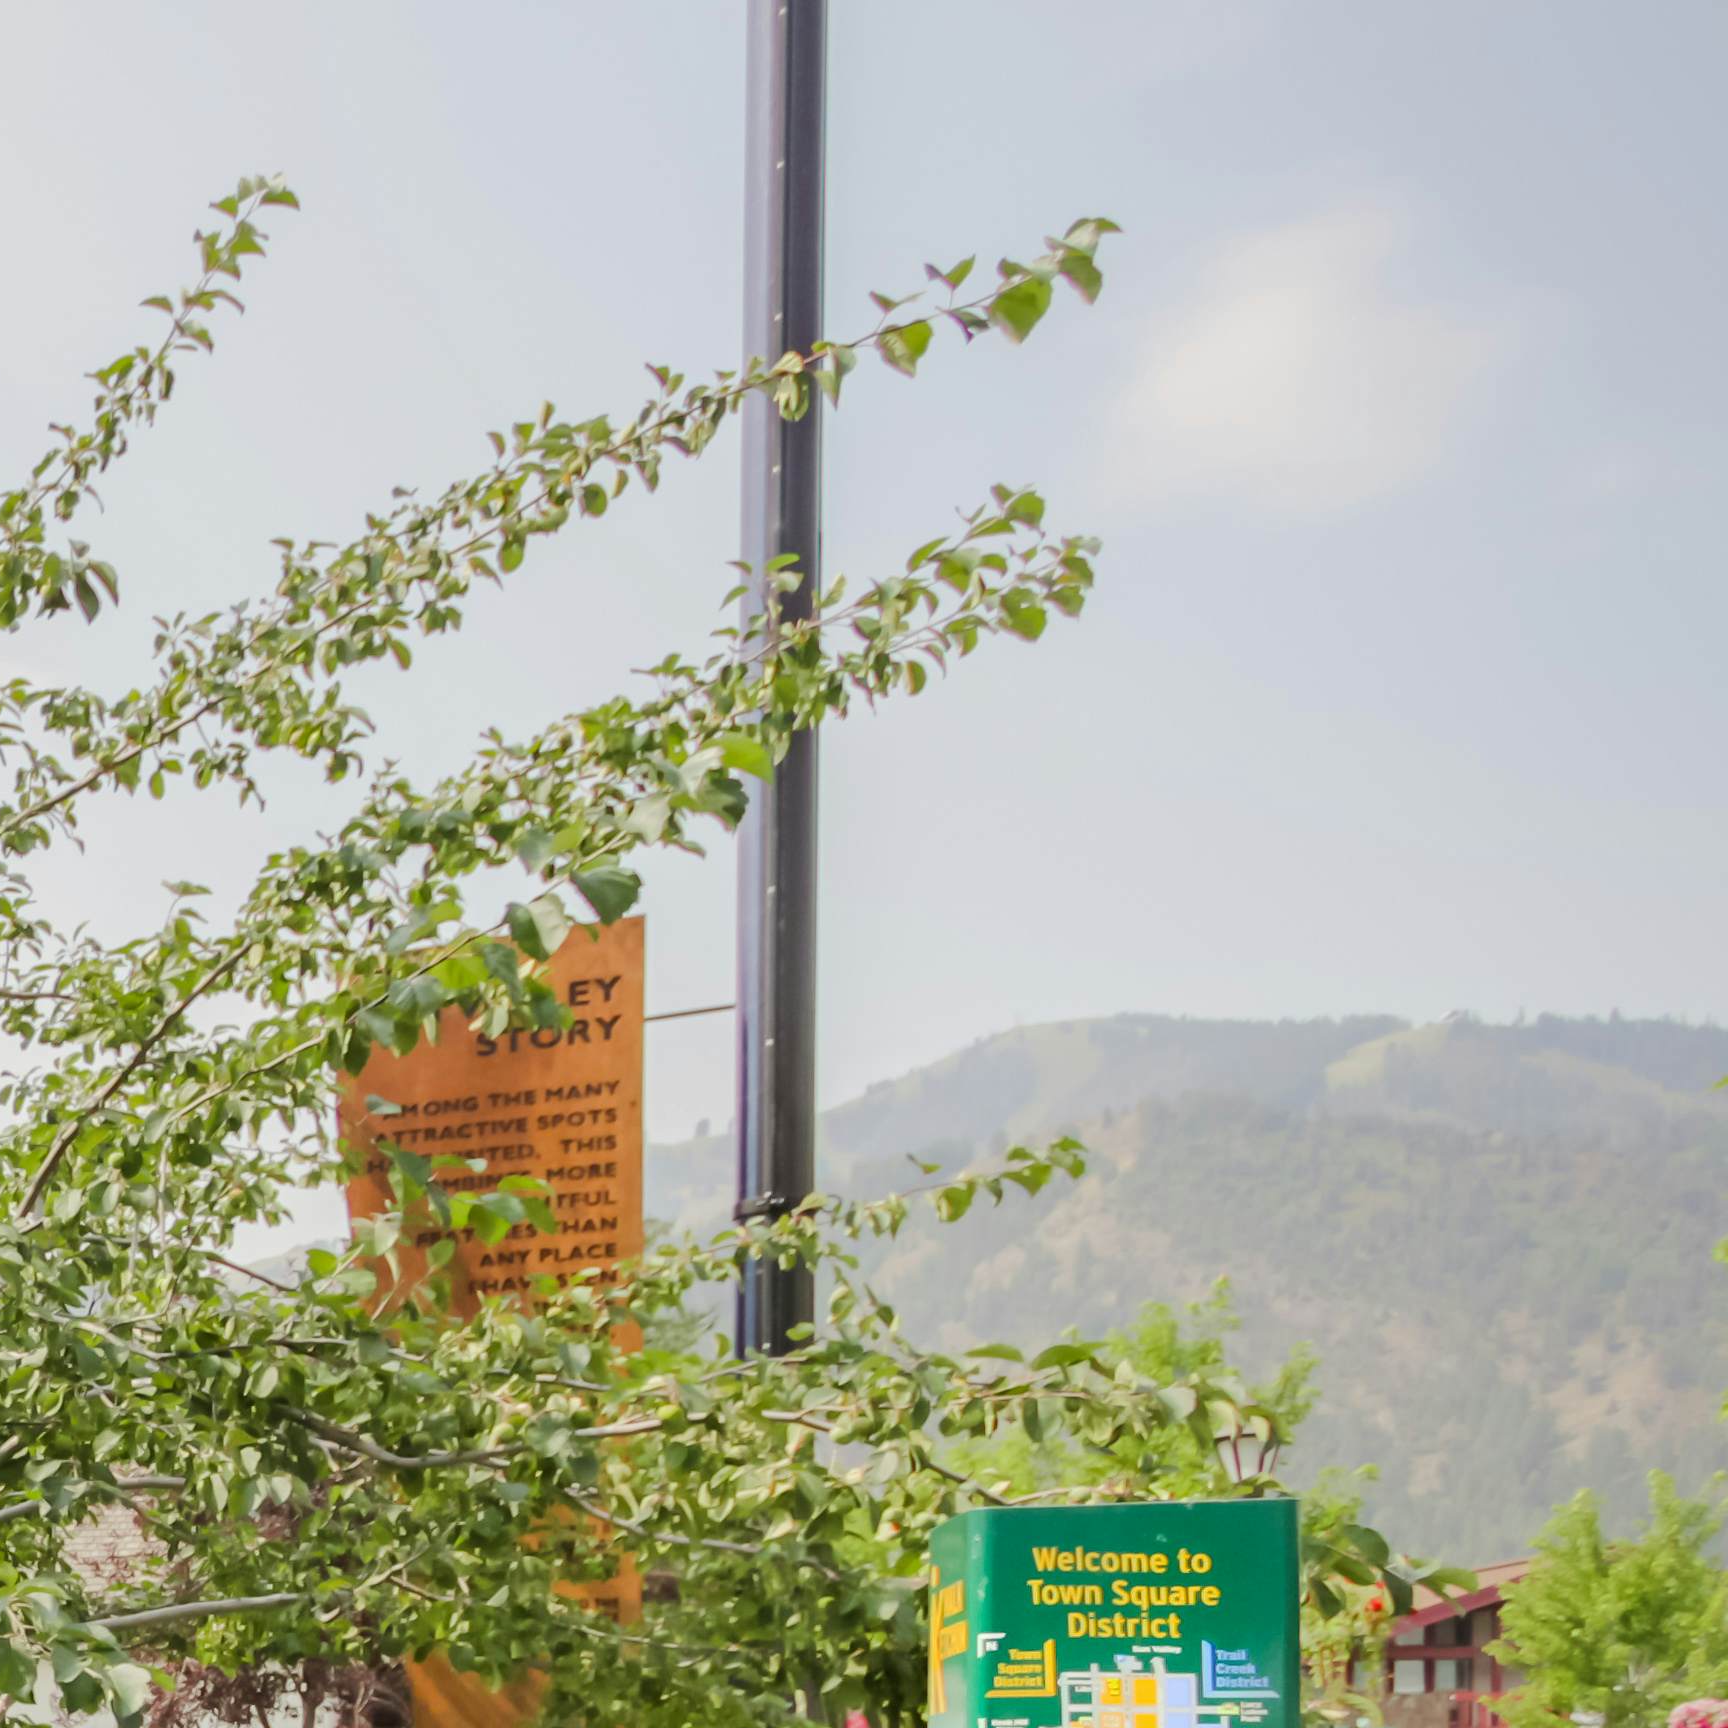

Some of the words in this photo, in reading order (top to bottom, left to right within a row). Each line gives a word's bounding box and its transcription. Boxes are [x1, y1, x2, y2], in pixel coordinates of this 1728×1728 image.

[475, 1014, 622, 1056] STORY
[487, 1089, 537, 1107] THE
[544, 1080, 620, 1102] MANY
[537, 1108, 618, 1131] SPOTS
[559, 1134, 618, 1155] THIS
[546, 1161, 618, 1182] MORE
[479, 1249, 532, 1268] ANY
[539, 1242, 617, 1263] PLACE
[1031, 1545, 1170, 1574] Welcome
[1176, 1547, 1213, 1574] to
[1026, 1578, 1105, 1606] Town
[1111, 1578, 1222, 1612] Square
[1067, 1611, 1182, 1639] District
[1215, 1649, 1249, 1661] Trail
[1215, 1663, 1257, 1675] Creek
[1215, 1676, 1270, 1688] District
